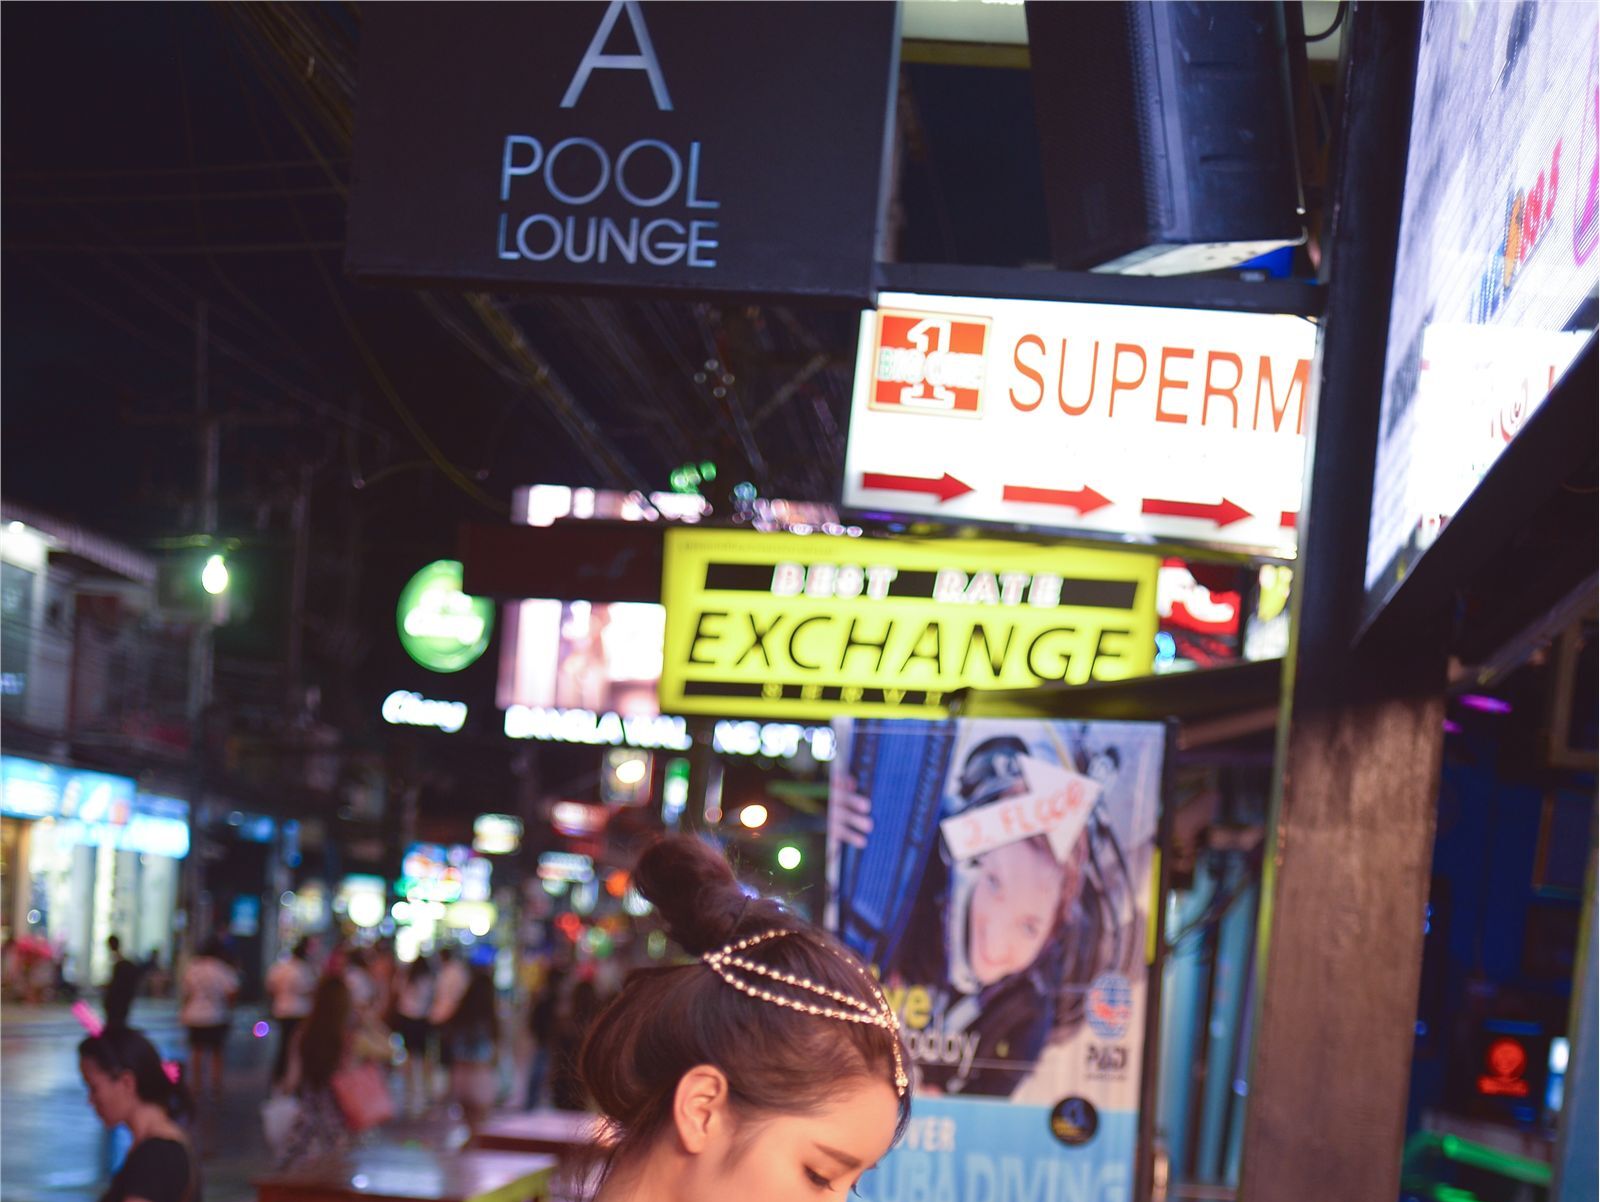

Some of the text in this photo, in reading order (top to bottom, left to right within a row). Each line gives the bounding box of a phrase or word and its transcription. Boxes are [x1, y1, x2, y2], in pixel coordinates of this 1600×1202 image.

[560, 0, 674, 111] A
[502, 135, 720, 209] POOL
[498, 212, 719, 268] LOUNGE
[770, 562, 1064, 608] BEST RATE
[688, 612, 1132, 686] EXCHANGE
